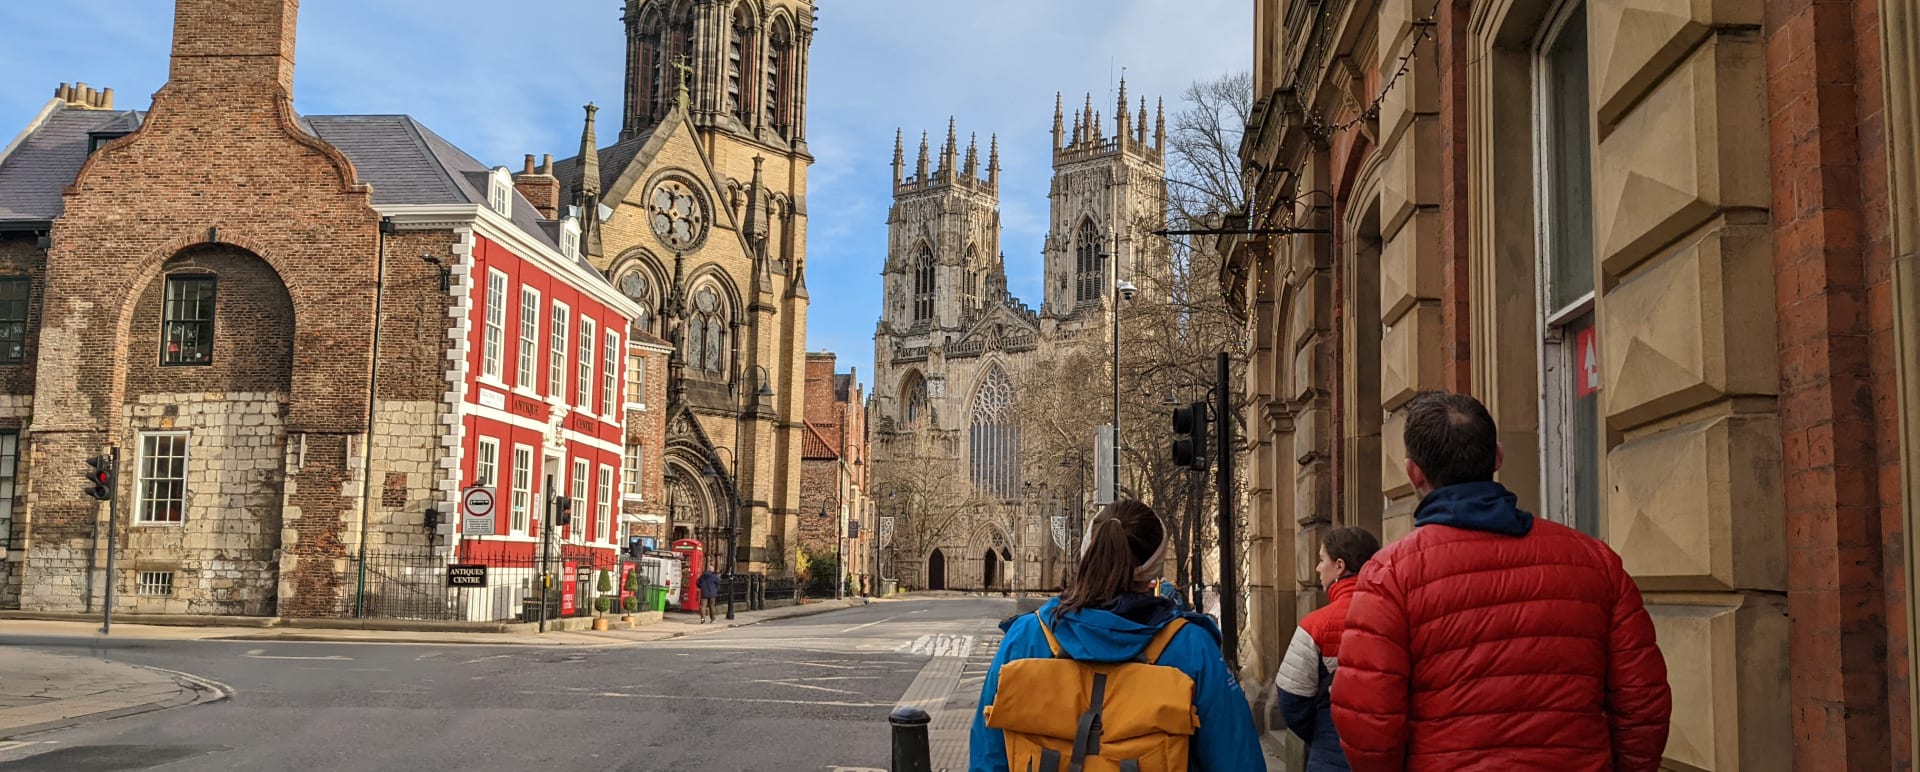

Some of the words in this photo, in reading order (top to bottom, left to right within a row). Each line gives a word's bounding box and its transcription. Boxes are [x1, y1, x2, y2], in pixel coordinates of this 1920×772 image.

[514, 400, 540, 416] ANTIQUE
[577, 418, 594, 432] CENTRE
[450, 568, 484, 576] ANTIQUES
[453, 576, 481, 584] CENTRE
